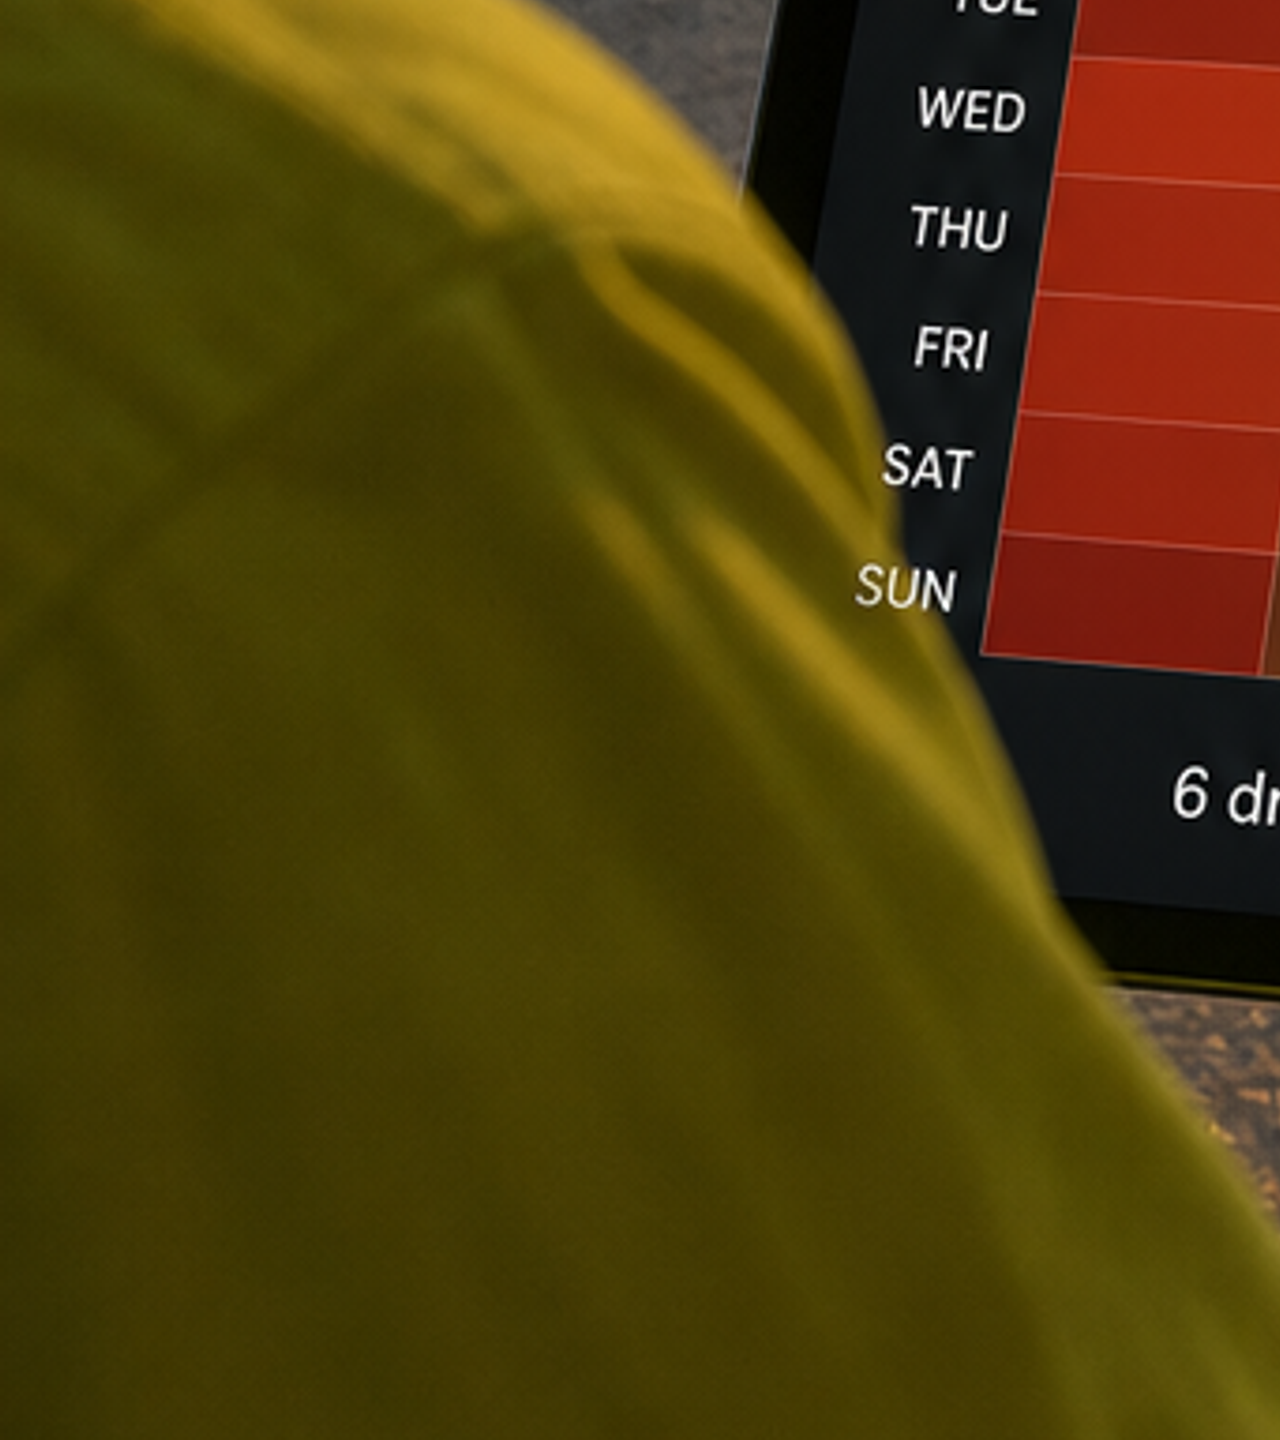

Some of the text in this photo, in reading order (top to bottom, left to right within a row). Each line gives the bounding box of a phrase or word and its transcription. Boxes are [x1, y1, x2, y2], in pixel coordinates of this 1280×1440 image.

[919, 86, 1026, 133] WED
[910, 204, 1008, 252] THU
[914, 325, 989, 372] FRI
[882, 443, 975, 491] SAT
[855, 563, 957, 613] SUN
[1173, 765, 1209, 819] 6
